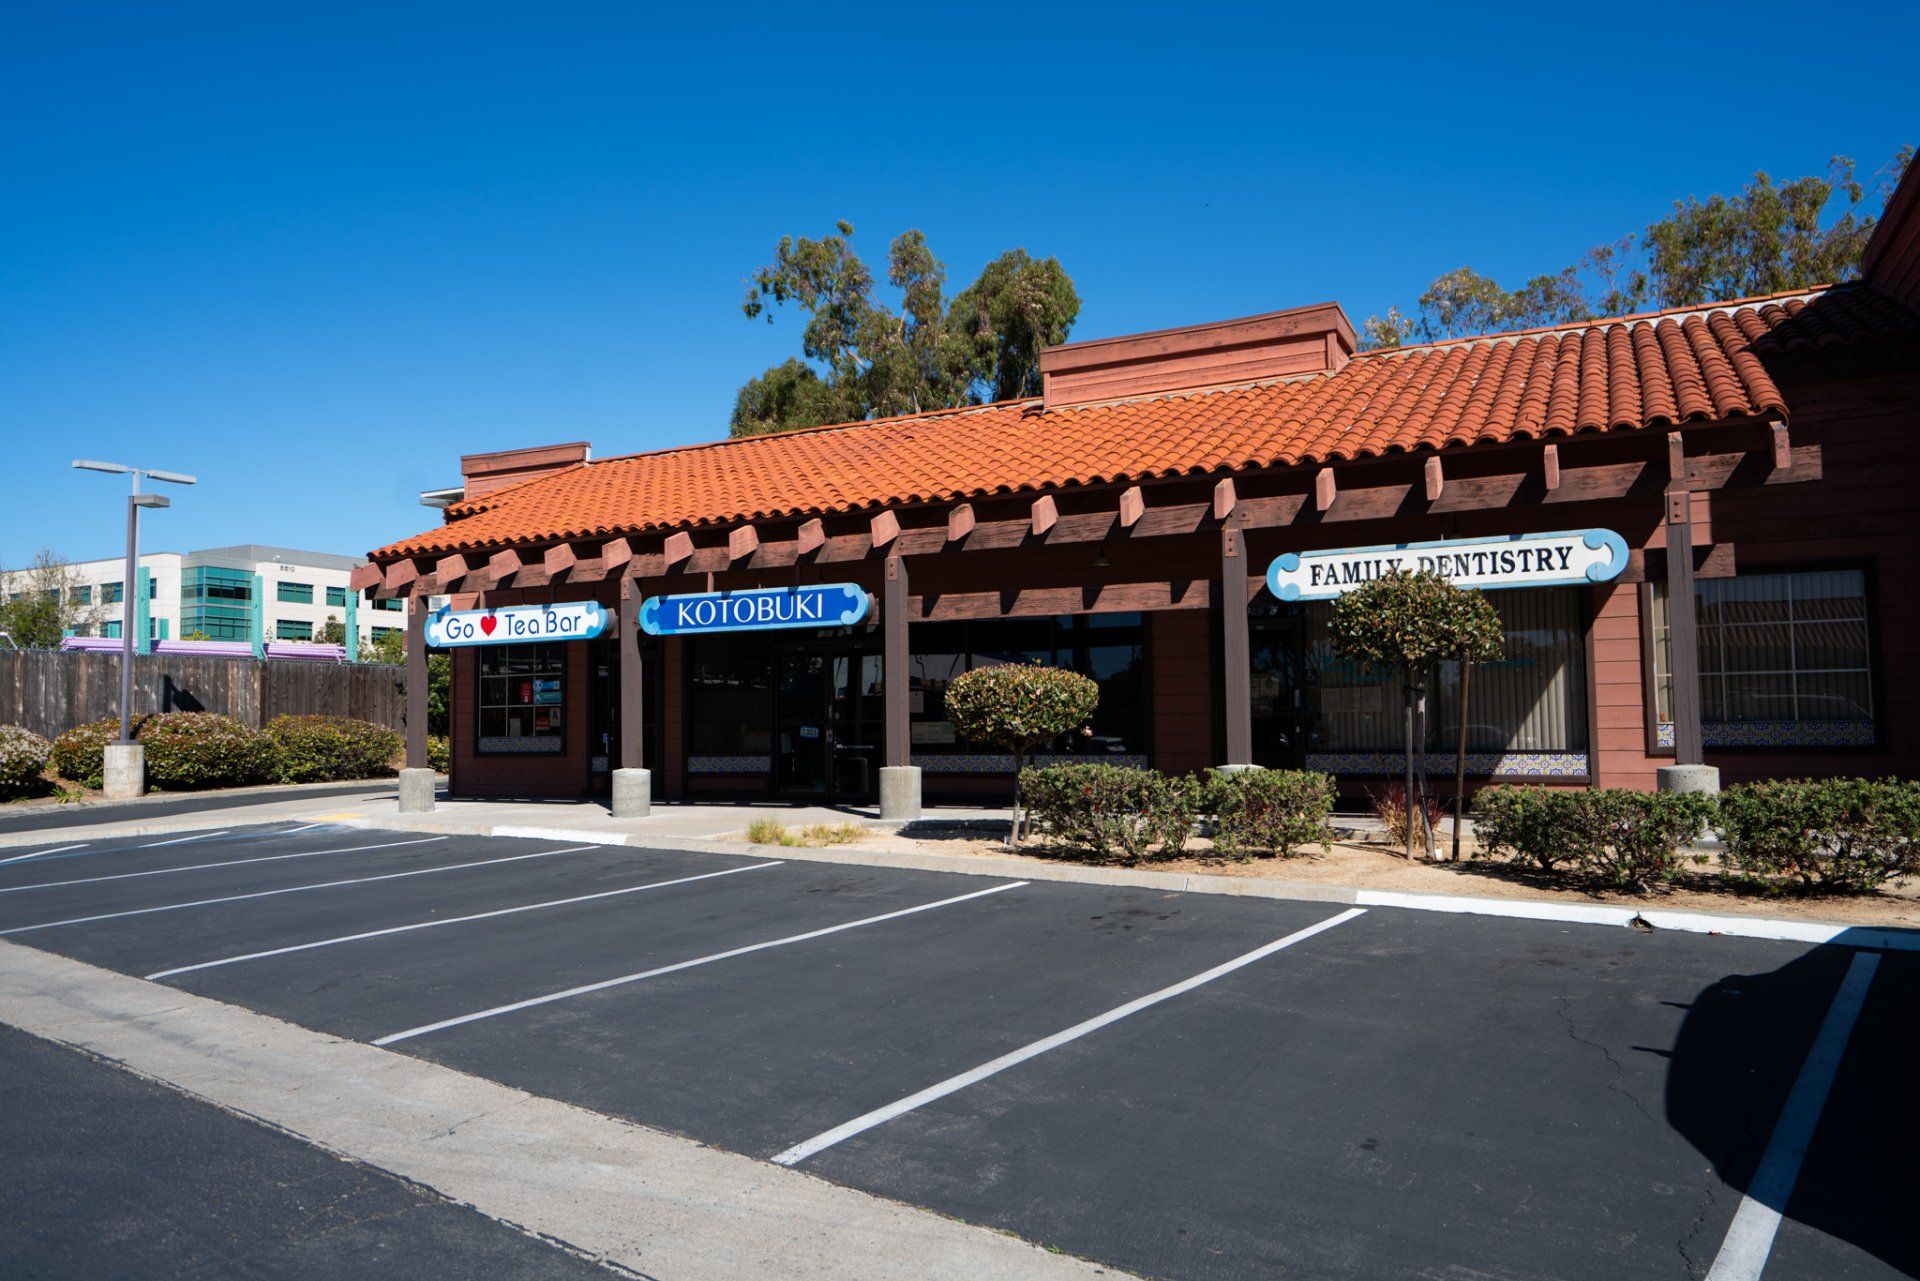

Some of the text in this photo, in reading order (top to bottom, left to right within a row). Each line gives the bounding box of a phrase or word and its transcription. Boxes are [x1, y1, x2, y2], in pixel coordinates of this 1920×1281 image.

[1417, 546, 1573, 579] DENTISTRY
[446, 610, 582, 640] Go Tea Bar
[678, 593, 822, 626] KOTOBUKI
